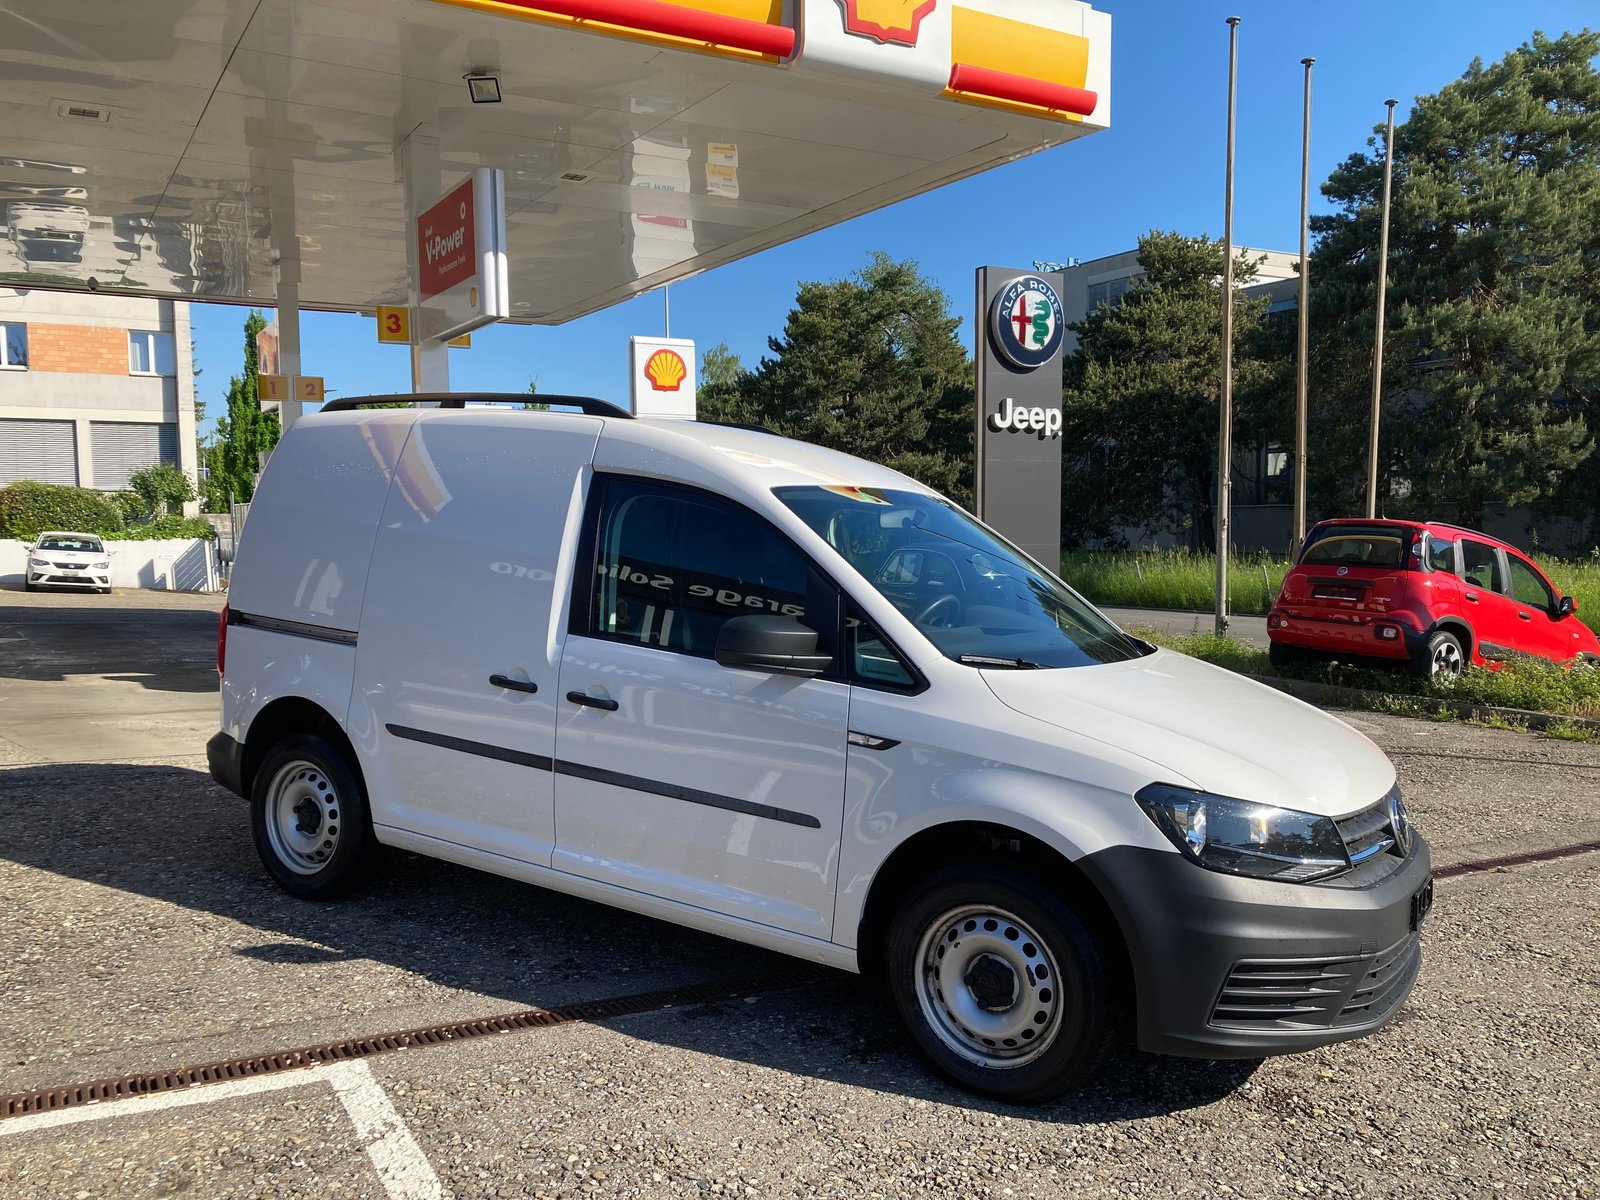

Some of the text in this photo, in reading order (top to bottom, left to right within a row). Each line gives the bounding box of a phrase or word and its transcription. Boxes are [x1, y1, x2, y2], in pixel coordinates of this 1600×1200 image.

[425, 225, 465, 265] V-Power
[1002, 280, 1062, 325] ALFA ROMEO
[386, 314, 402, 333] 3
[269, 381, 277, 395] 1
[305, 383, 316, 396] 2
[994, 397, 1062, 436] Jeep
